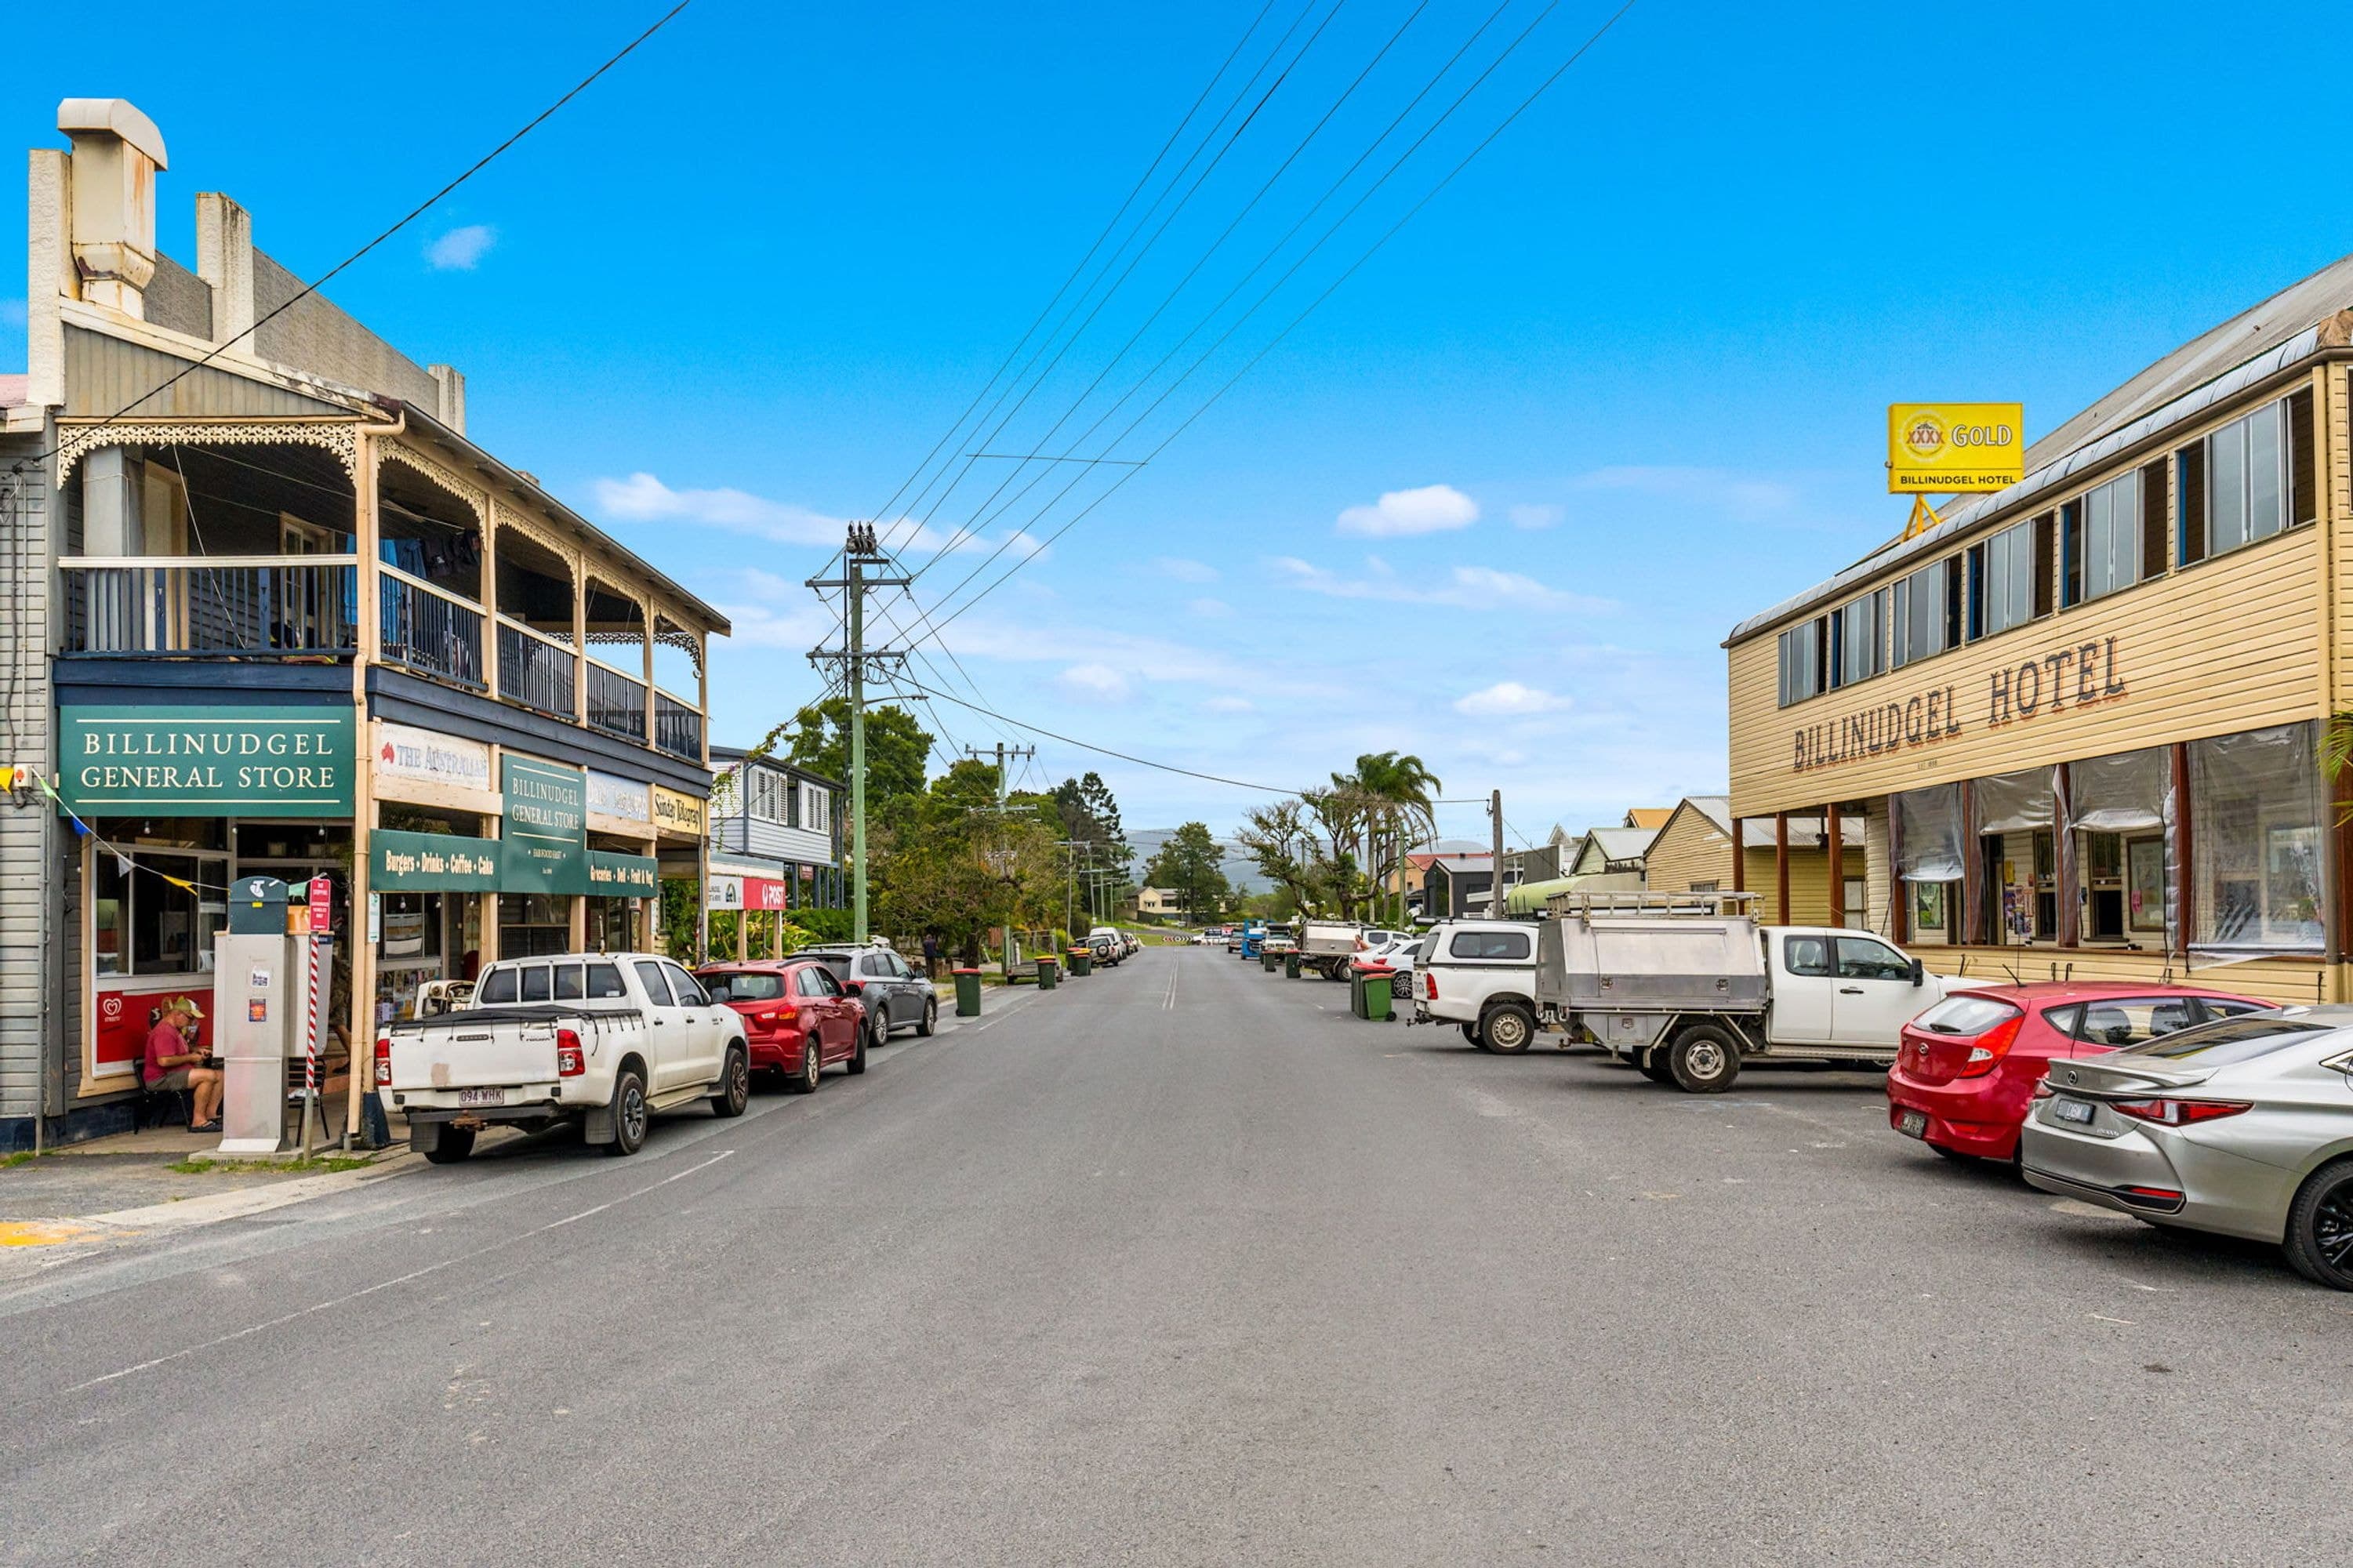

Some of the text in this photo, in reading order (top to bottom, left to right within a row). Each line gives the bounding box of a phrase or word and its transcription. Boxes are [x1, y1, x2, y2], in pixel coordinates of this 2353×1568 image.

[1906, 424, 2013, 447] XXXX GOLD
[1901, 475, 2016, 485] BILLINUDGEL HOTEL
[1793, 636, 2128, 771] BILLINUDGEL HOTEL
[83, 733, 333, 755] BILLINUDGEL
[397, 745, 421, 768] THE
[81, 766, 334, 788] GENERAL STORE
[513, 778, 579, 806] BILLINUDGEL
[512, 804, 579, 829] GENERAL STORE
[676, 799, 699, 829] Telegrap
[386, 850, 494, 877] Burgers Drinks Coffee Cake
[768, 885, 784, 905] POST
